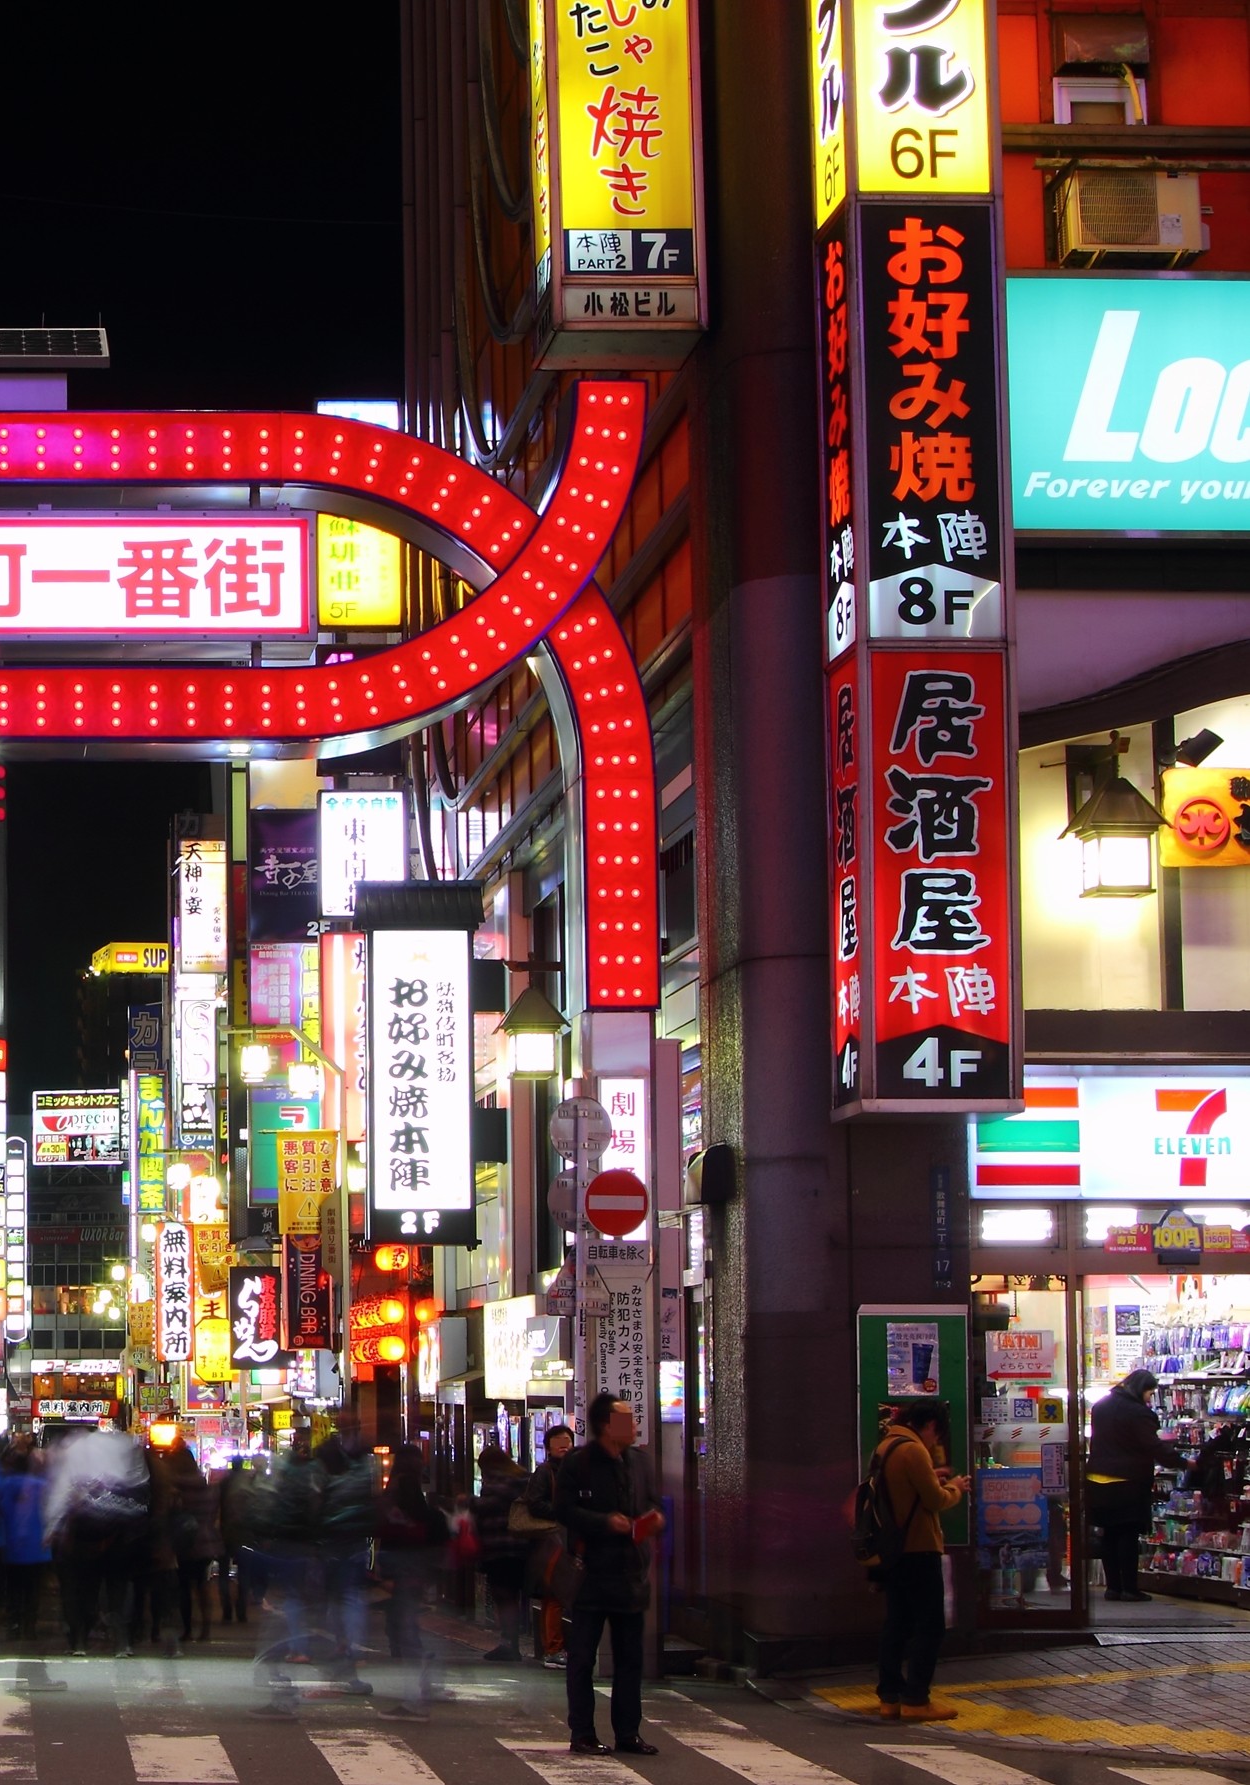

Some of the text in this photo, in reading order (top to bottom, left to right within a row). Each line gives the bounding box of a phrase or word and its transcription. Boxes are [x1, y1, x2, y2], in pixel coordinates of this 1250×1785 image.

[570, 3, 619, 76] たこ
[587, 86, 663, 215] 焼き
[890, 127, 958, 179] 6F
[824, 143, 840, 206] 6F
[576, 233, 621, 254] 本陣
[578, 254, 627, 269] PART2
[641, 233, 679, 269] 7F
[584, 292, 675, 317] 小松ビル
[886, 217, 976, 503] お好み焼
[825, 241, 850, 528] お好み焼
[1023, 472, 1171, 499] Forever
[830, 523, 854, 583] 本陣
[881, 509, 988, 562] 本陣
[329, 602, 357, 618] 5F
[836, 595, 852, 642] 8F
[898, 577, 975, 625] 8F
[836, 683, 859, 964] 居酒屋
[884, 669, 994, 956] 居酒屋
[213, 843, 223, 851] 5F
[185, 842, 203, 915] 天神の宴
[307, 921, 331, 936] 2F
[143, 948, 167, 968] SUP
[837, 975, 860, 1026] 本陣
[888, 965, 997, 1017] 本陣
[388, 978, 431, 1192] お好み焼本陣
[842, 1042, 859, 1089] 4F
[902, 1037, 982, 1089] 4F
[37, 1095, 120, 1107] コミック&ネットカフェ
[139, 1077, 164, 1209] まんが喫茶
[283, 1140, 334, 1156] 悪質な
[1155, 1088, 1227, 1187] 7
[283, 1159, 332, 1175] 客引き
[284, 1177, 334, 1193] に注意
[81, 1227, 125, 1241] LUXOR Bar
[327, 1208, 336, 1264] 劇場通り一番街
[400, 1211, 440, 1235] 2F
[1153, 1226, 1201, 1249] 100円
[587, 1245, 645, 1260] 自転車を除く
[936, 1260, 950, 1272] 17
[163, 1229, 188, 1354] 無料案内所
[260, 1275, 276, 1339] 東京豚骨
[301, 1253, 316, 1334] DINING BAR
[45, 1361, 81, 1371] コーヒー
[600, 1342, 609, 1374] Camera
[608, 1329, 617, 1356] Safety
[631, 1285, 645, 1425] みなさまの安全を守ります
[39, 1400, 104, 1412] 無料案内所
